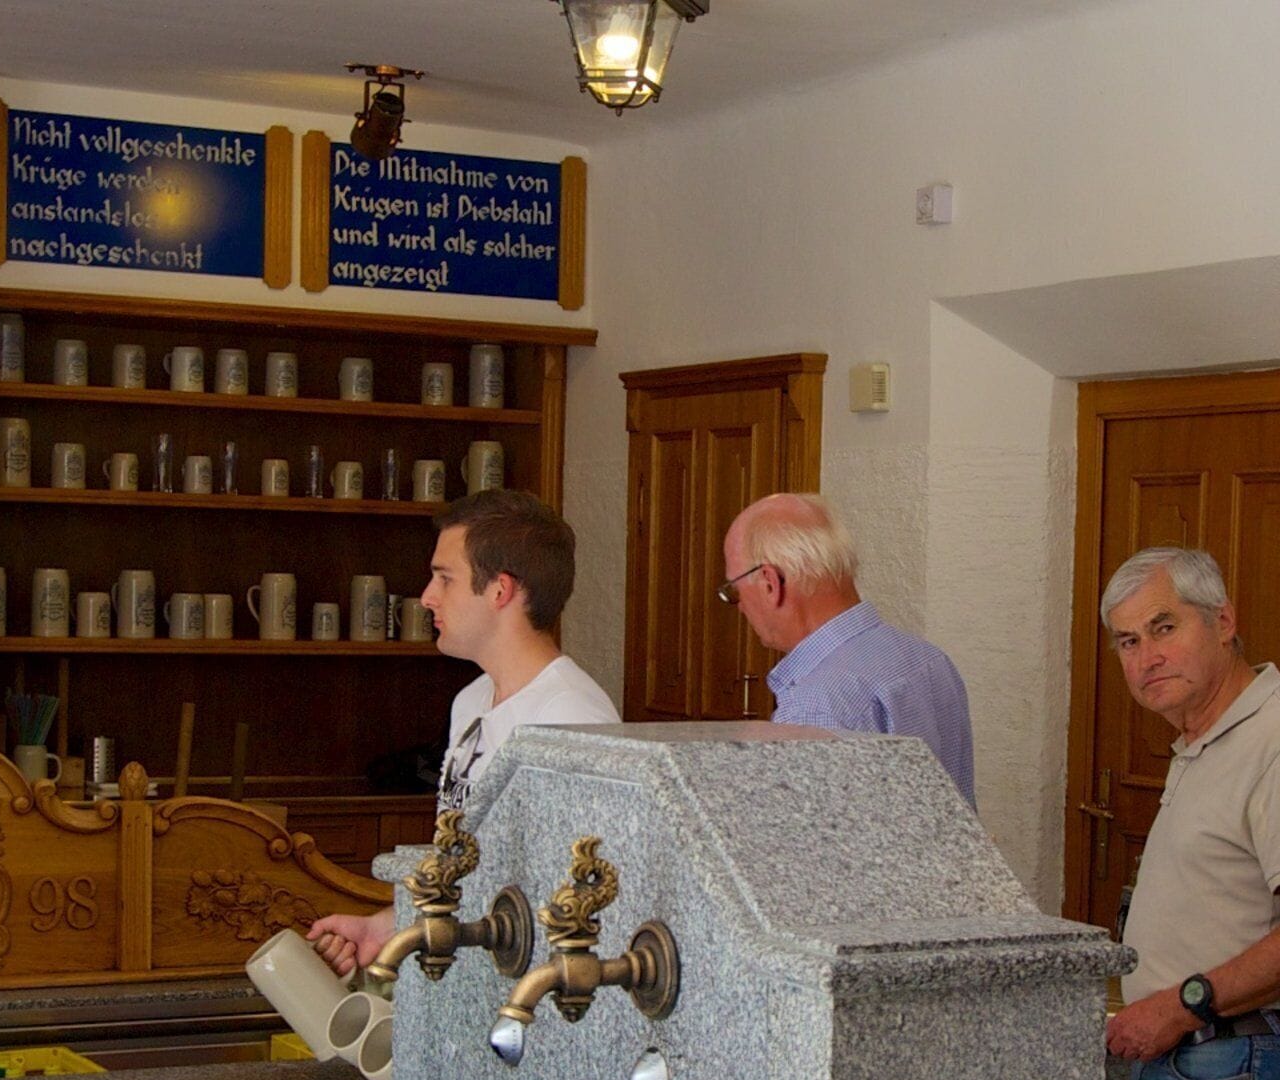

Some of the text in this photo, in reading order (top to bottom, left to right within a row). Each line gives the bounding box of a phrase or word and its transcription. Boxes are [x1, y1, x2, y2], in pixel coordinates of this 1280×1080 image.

[13, 117, 257, 166] Nicht vollgeschenkte
[12, 153, 87, 190] Krüge
[334, 149, 550, 194] Die Mitnahme von
[334, 184, 553, 225] Krügen ist Diebstahl
[10, 233, 203, 270] nachgeschenkt
[333, 221, 556, 261] und wird als solcher
[333, 260, 450, 291] angezeigt
[28, 876, 98, 932] 98
